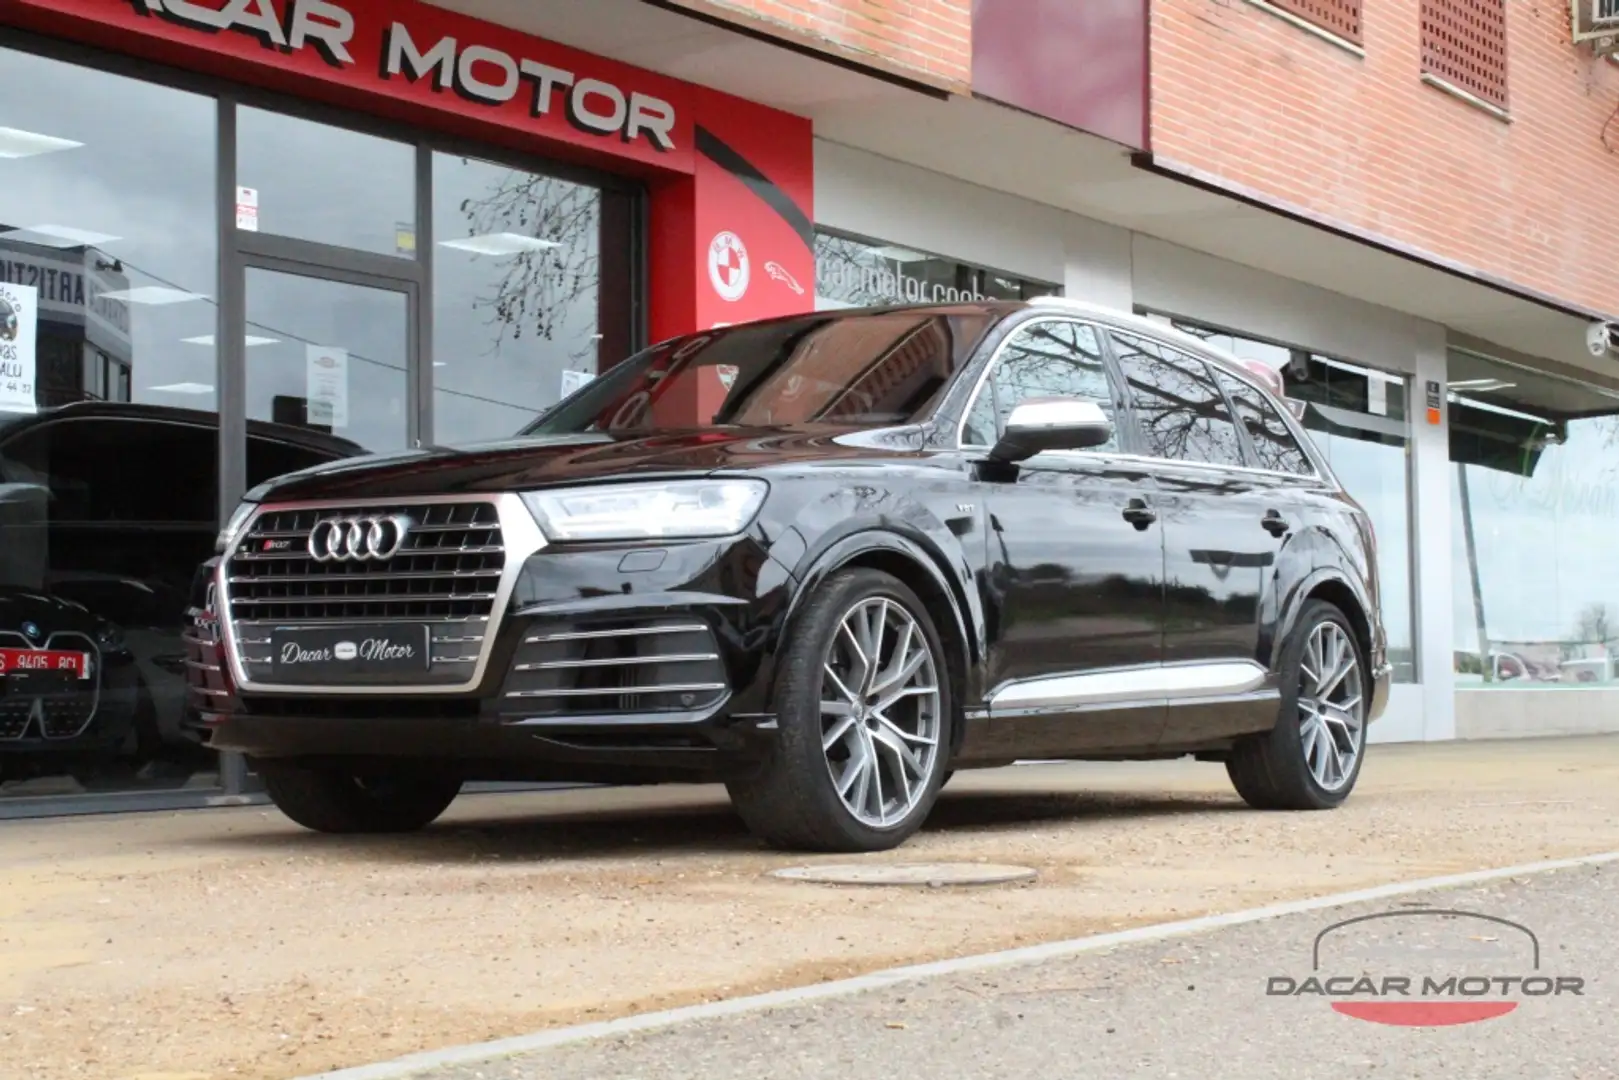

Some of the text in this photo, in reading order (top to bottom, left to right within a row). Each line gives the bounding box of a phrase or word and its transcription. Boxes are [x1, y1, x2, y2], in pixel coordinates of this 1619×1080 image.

[386, 21, 676, 150] MOTOR
[280, 638, 416, 664] Dacar Motor
